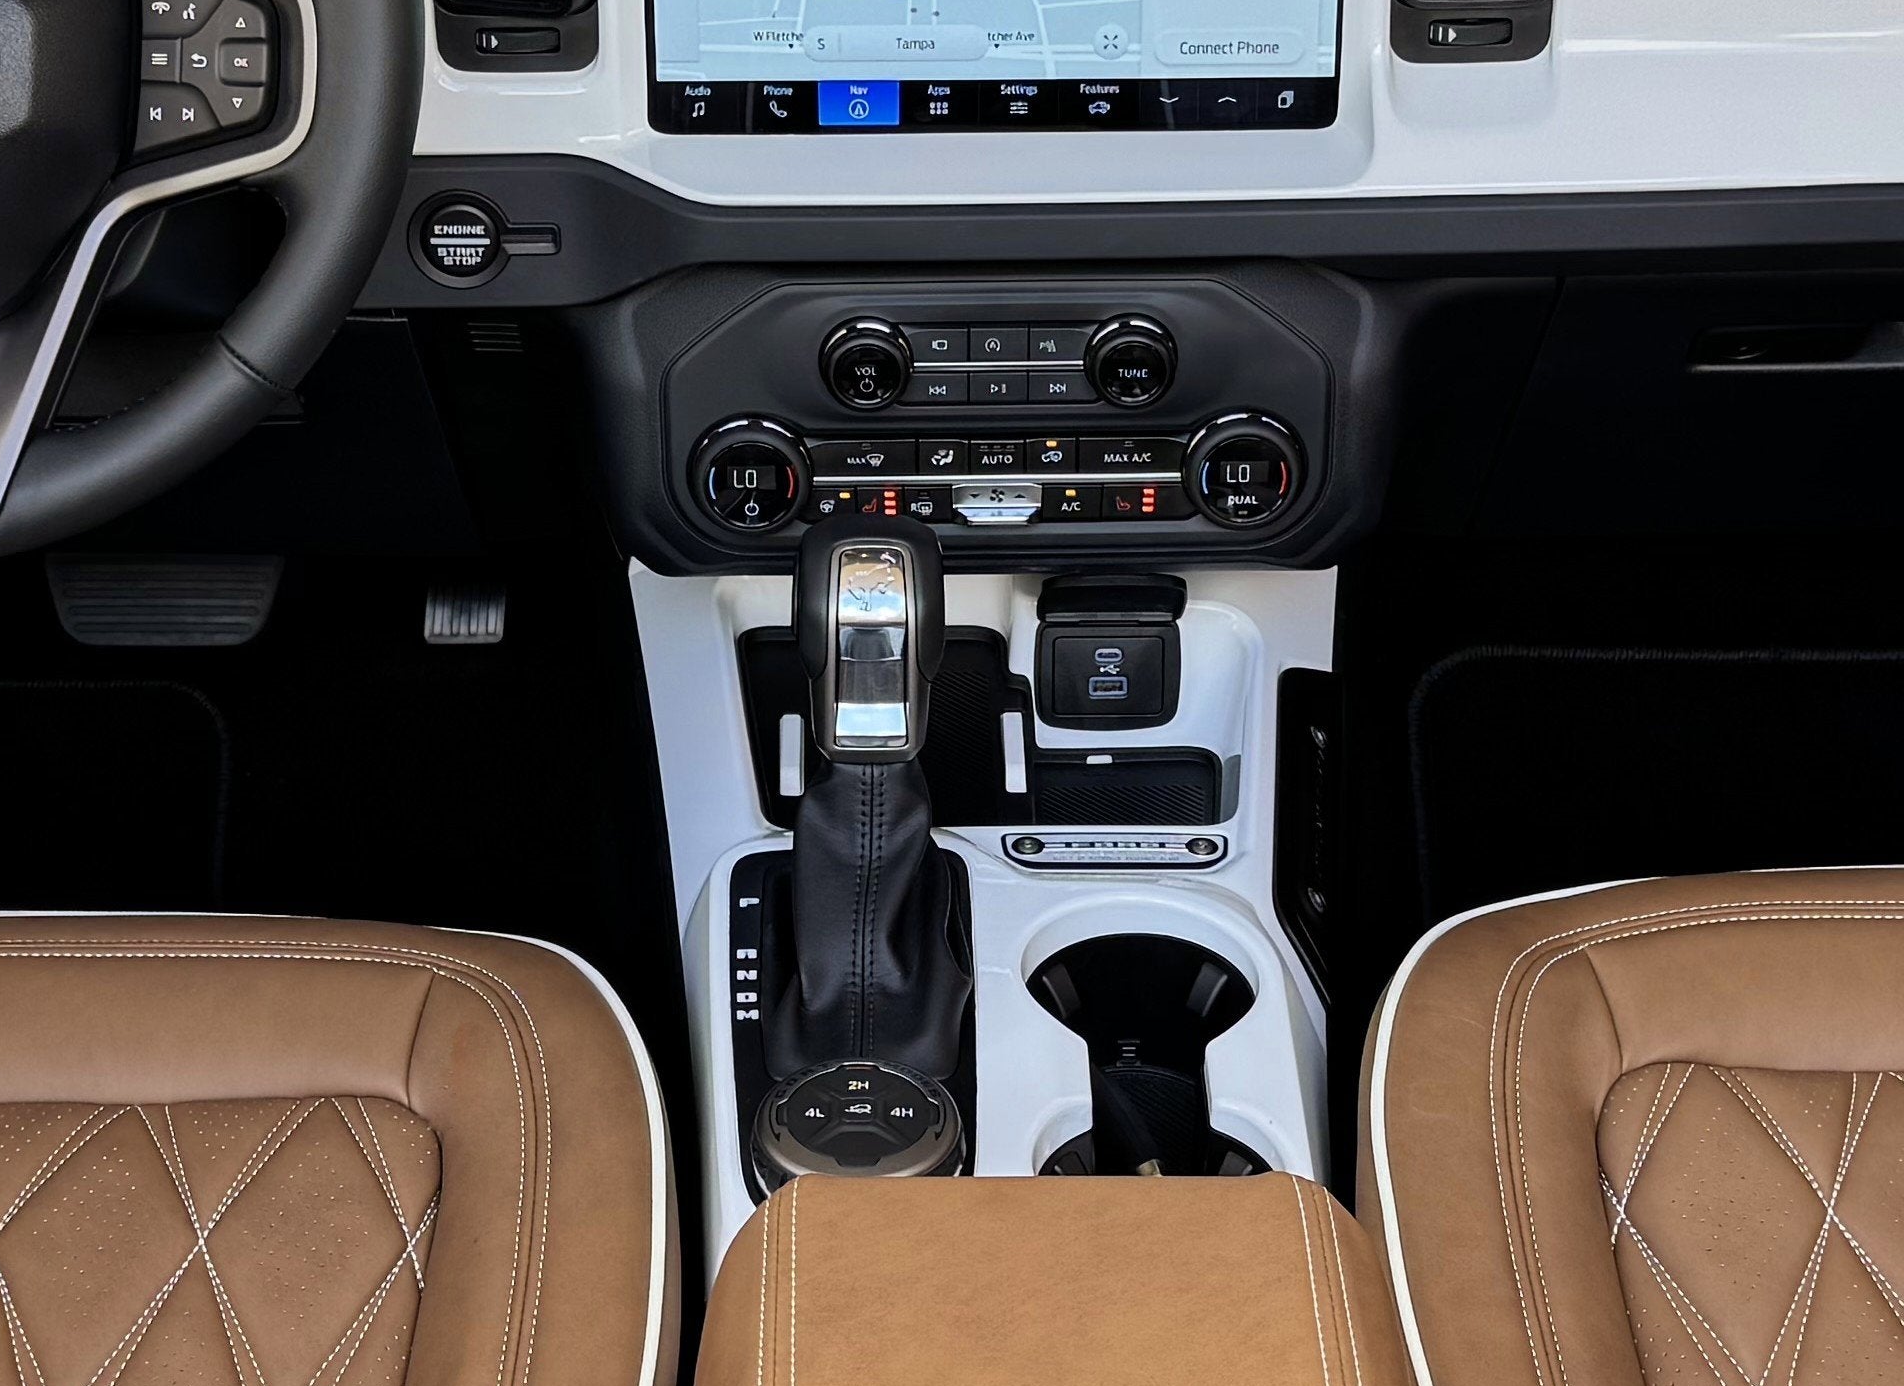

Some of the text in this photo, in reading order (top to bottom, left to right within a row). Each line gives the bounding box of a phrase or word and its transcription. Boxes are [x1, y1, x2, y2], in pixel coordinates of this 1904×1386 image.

[753, 30, 766, 42] W
[1014, 31, 1035, 41] Ave
[817, 38, 826, 50] S
[896, 37, 935, 51] Tampa
[1180, 41, 1280, 55] Connect Phone
[233, 57, 249, 68] OK
[685, 85, 712, 97] Audio
[763, 85, 794, 97] Phone
[849, 85, 869, 96] Nav
[927, 85, 951, 98] Apps
[1000, 84, 1038, 97] Settings
[1079, 84, 1120, 95] Features
[433, 225, 485, 236] ENGINE
[437, 247, 485, 257] START
[443, 256, 482, 266] STOP
[854, 365, 878, 376] VOL
[1117, 366, 1149, 379] TUNE
[981, 454, 1014, 466] AUTO
[1103, 452, 1153, 465] MAX A/C
[732, 466, 758, 490] LO
[1225, 462, 1251, 485] LO
[1061, 500, 1082, 513] A/C
[1226, 494, 1259, 507] DUAL
[848, 1080, 869, 1091] 2H
[804, 1107, 825, 1118] 4L
[890, 1107, 914, 1118] 4H
